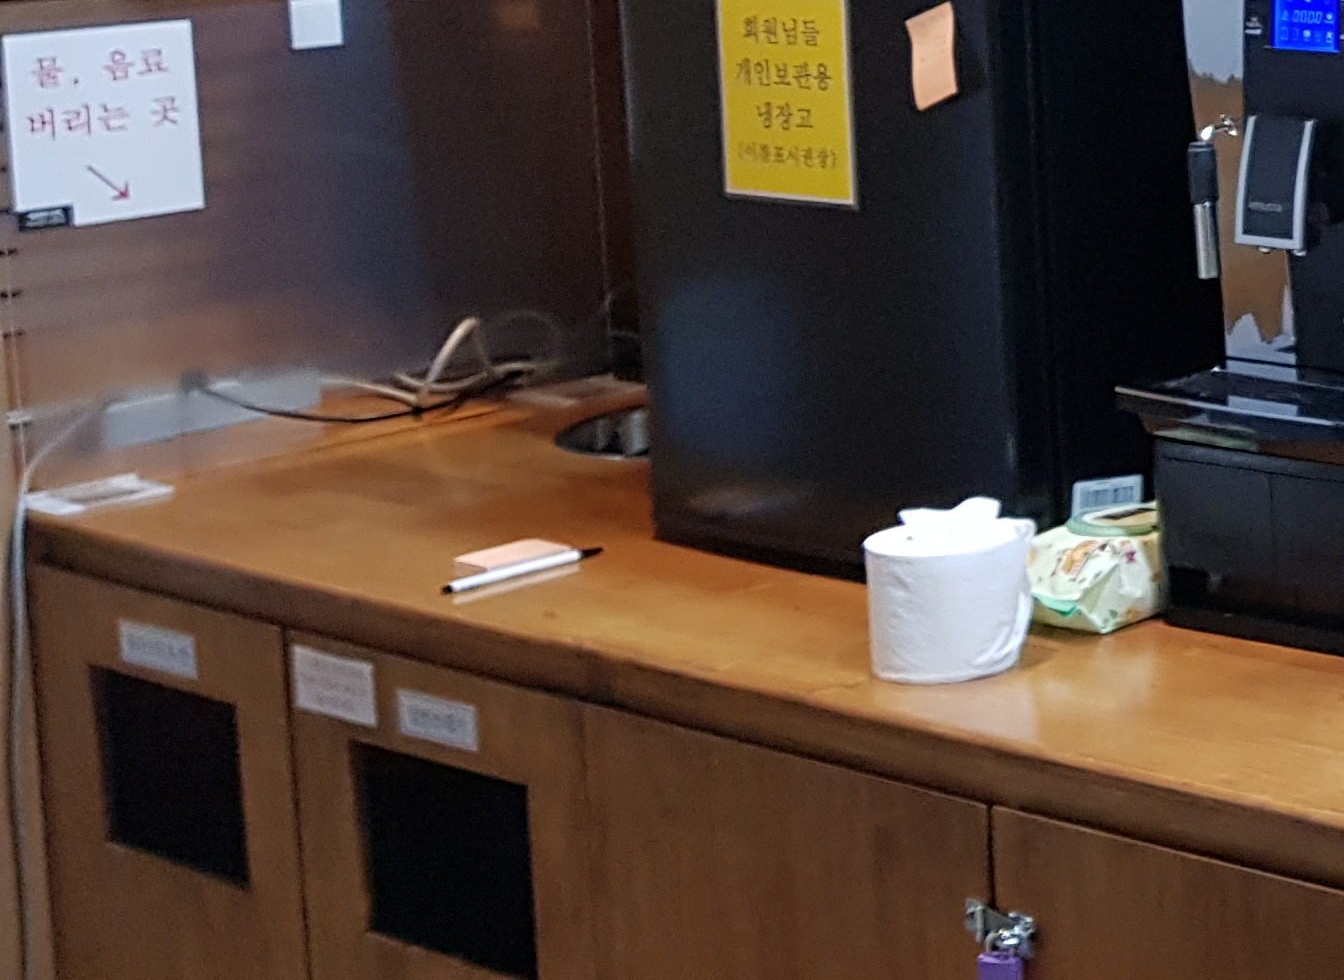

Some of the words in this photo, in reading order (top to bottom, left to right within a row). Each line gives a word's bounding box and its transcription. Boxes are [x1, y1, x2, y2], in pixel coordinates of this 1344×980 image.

[742, 15, 819, 46] 회원님들
[103, 48, 168, 81] 음료
[736, 57, 832, 90] 개인보관용
[27, 103, 130, 139] 버리는
[151, 95, 180, 126] 곳
[756, 102, 814, 130] 냉장고
